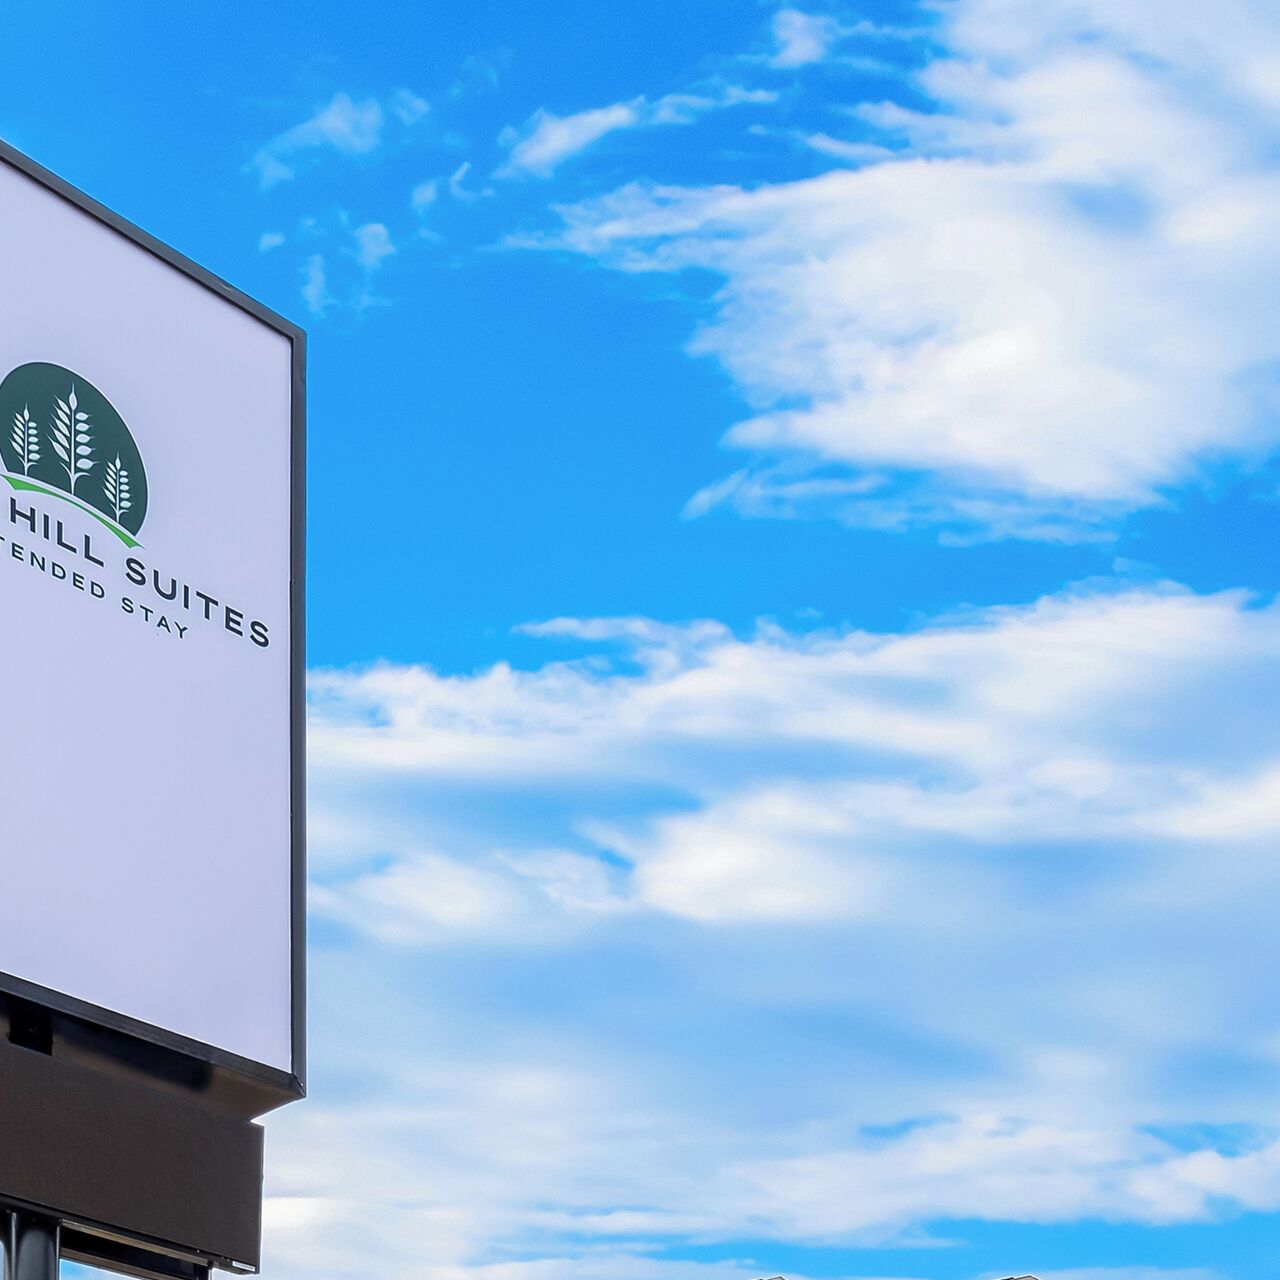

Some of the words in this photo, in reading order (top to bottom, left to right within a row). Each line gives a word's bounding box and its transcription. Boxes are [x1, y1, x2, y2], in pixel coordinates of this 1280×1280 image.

[9, 496, 105, 568] HILL
[125, 557, 271, 648] SUITES
[120, 596, 189, 640] STAY
